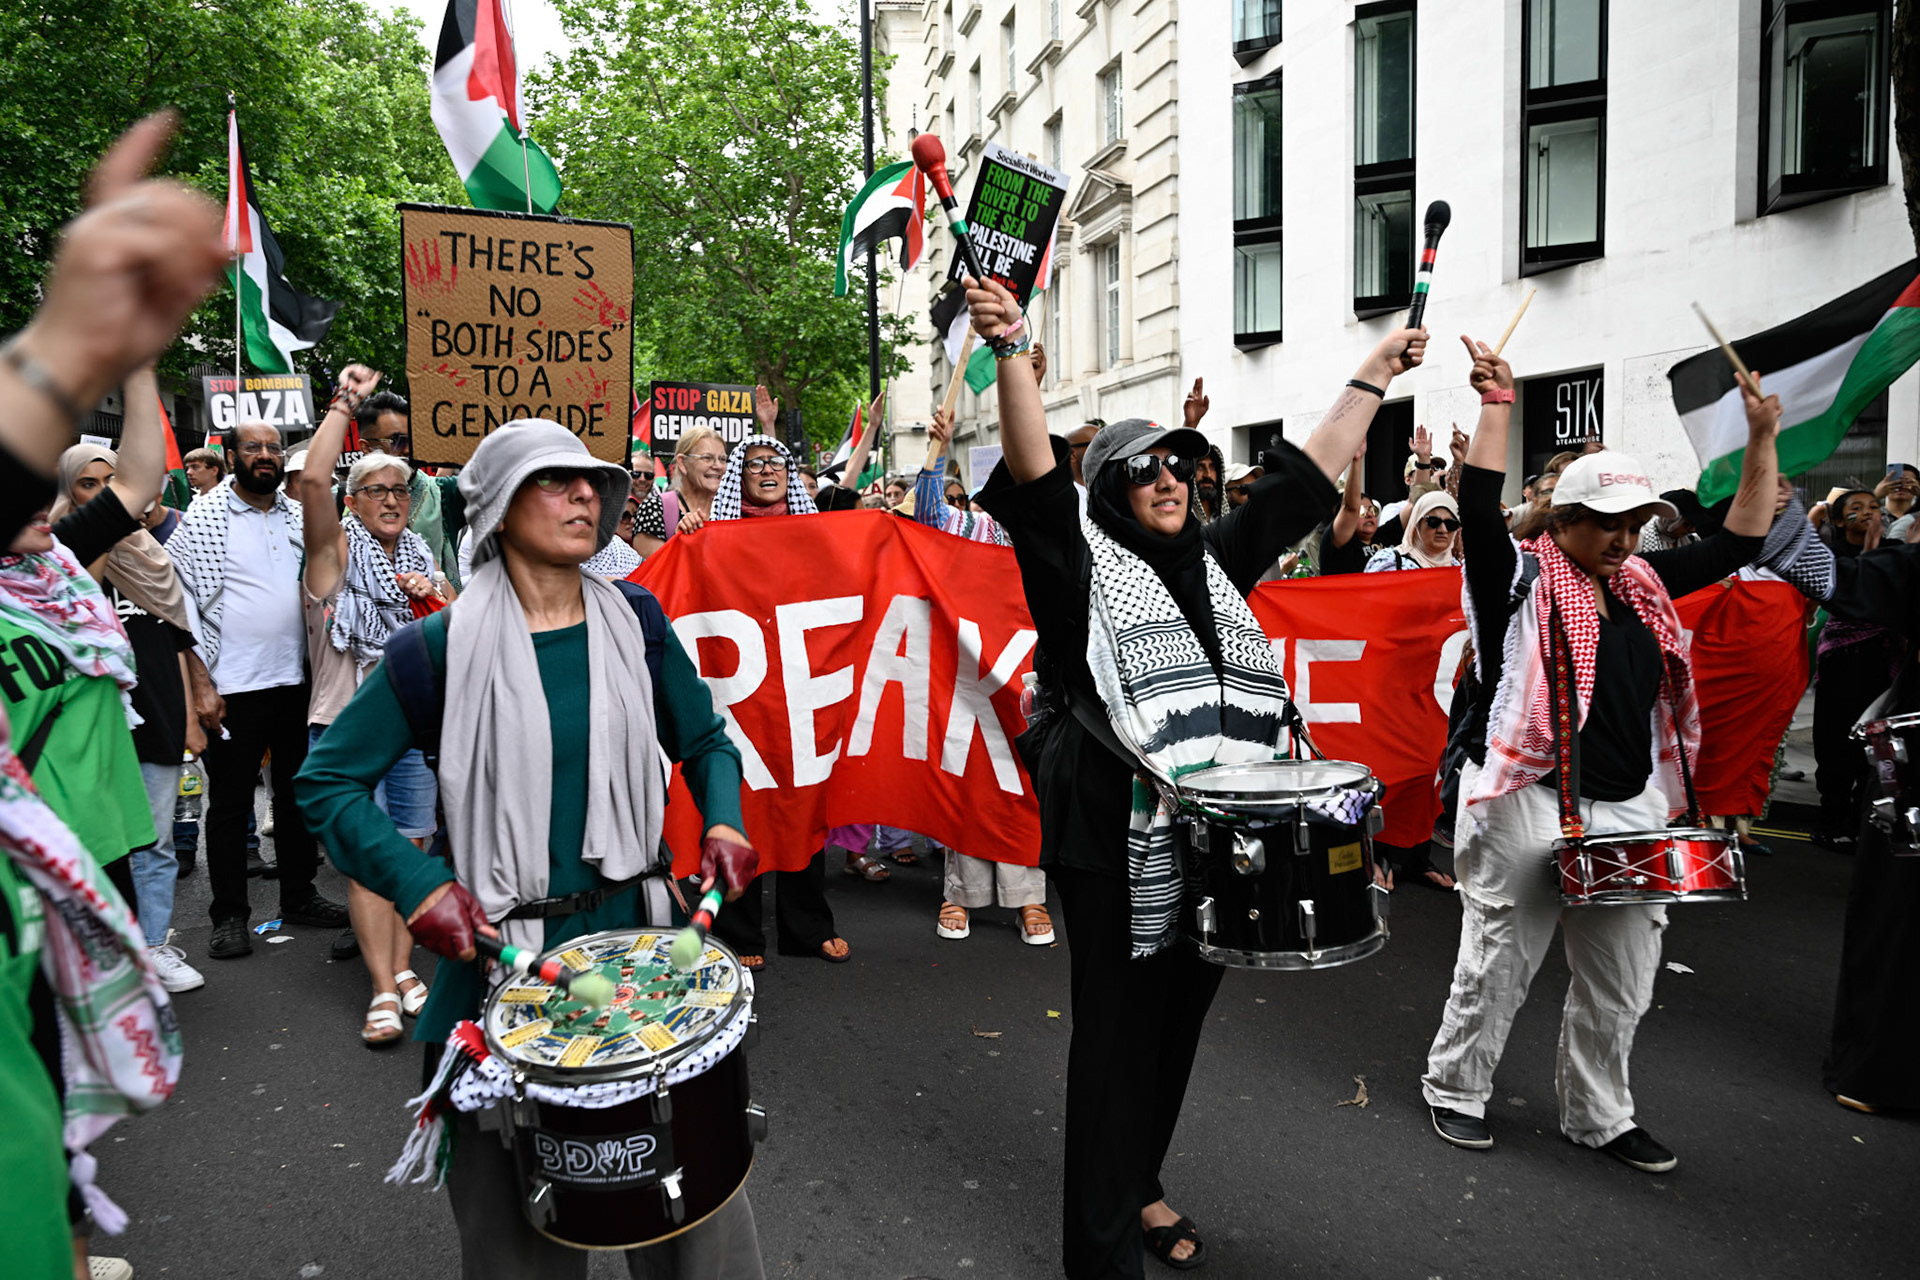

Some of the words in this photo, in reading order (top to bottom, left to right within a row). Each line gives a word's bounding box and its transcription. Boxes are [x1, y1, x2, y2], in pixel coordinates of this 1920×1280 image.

[985, 162, 1025, 195] FROM
[1026, 180, 1053, 206] THE
[996, 150, 1029, 171] Socialist
[1029, 163, 1056, 182] Worker
[974, 202, 1000, 229] THE
[1000, 213, 1026, 239] SEA
[980, 182, 1019, 215] RIVER
[1021, 199, 1039, 222] TO
[440, 230, 595, 280] THERE'S
[969, 221, 1037, 265] PALESTINE
[994, 253, 1014, 277] BE
[490, 284, 541, 318] NO
[417, 308, 515, 358] "BOTH
[526, 322, 625, 363] SIDES"
[245, 377, 304, 391] BOMBING
[471, 364, 519, 397] TO
[529, 365, 552, 398] A
[211, 390, 309, 430] GAZA
[654, 386, 701, 411] STOP
[706, 389, 753, 414] GAZA
[1556, 378, 1600, 439] STK
[1556, 435, 1600, 446] STEAKHOUSE
